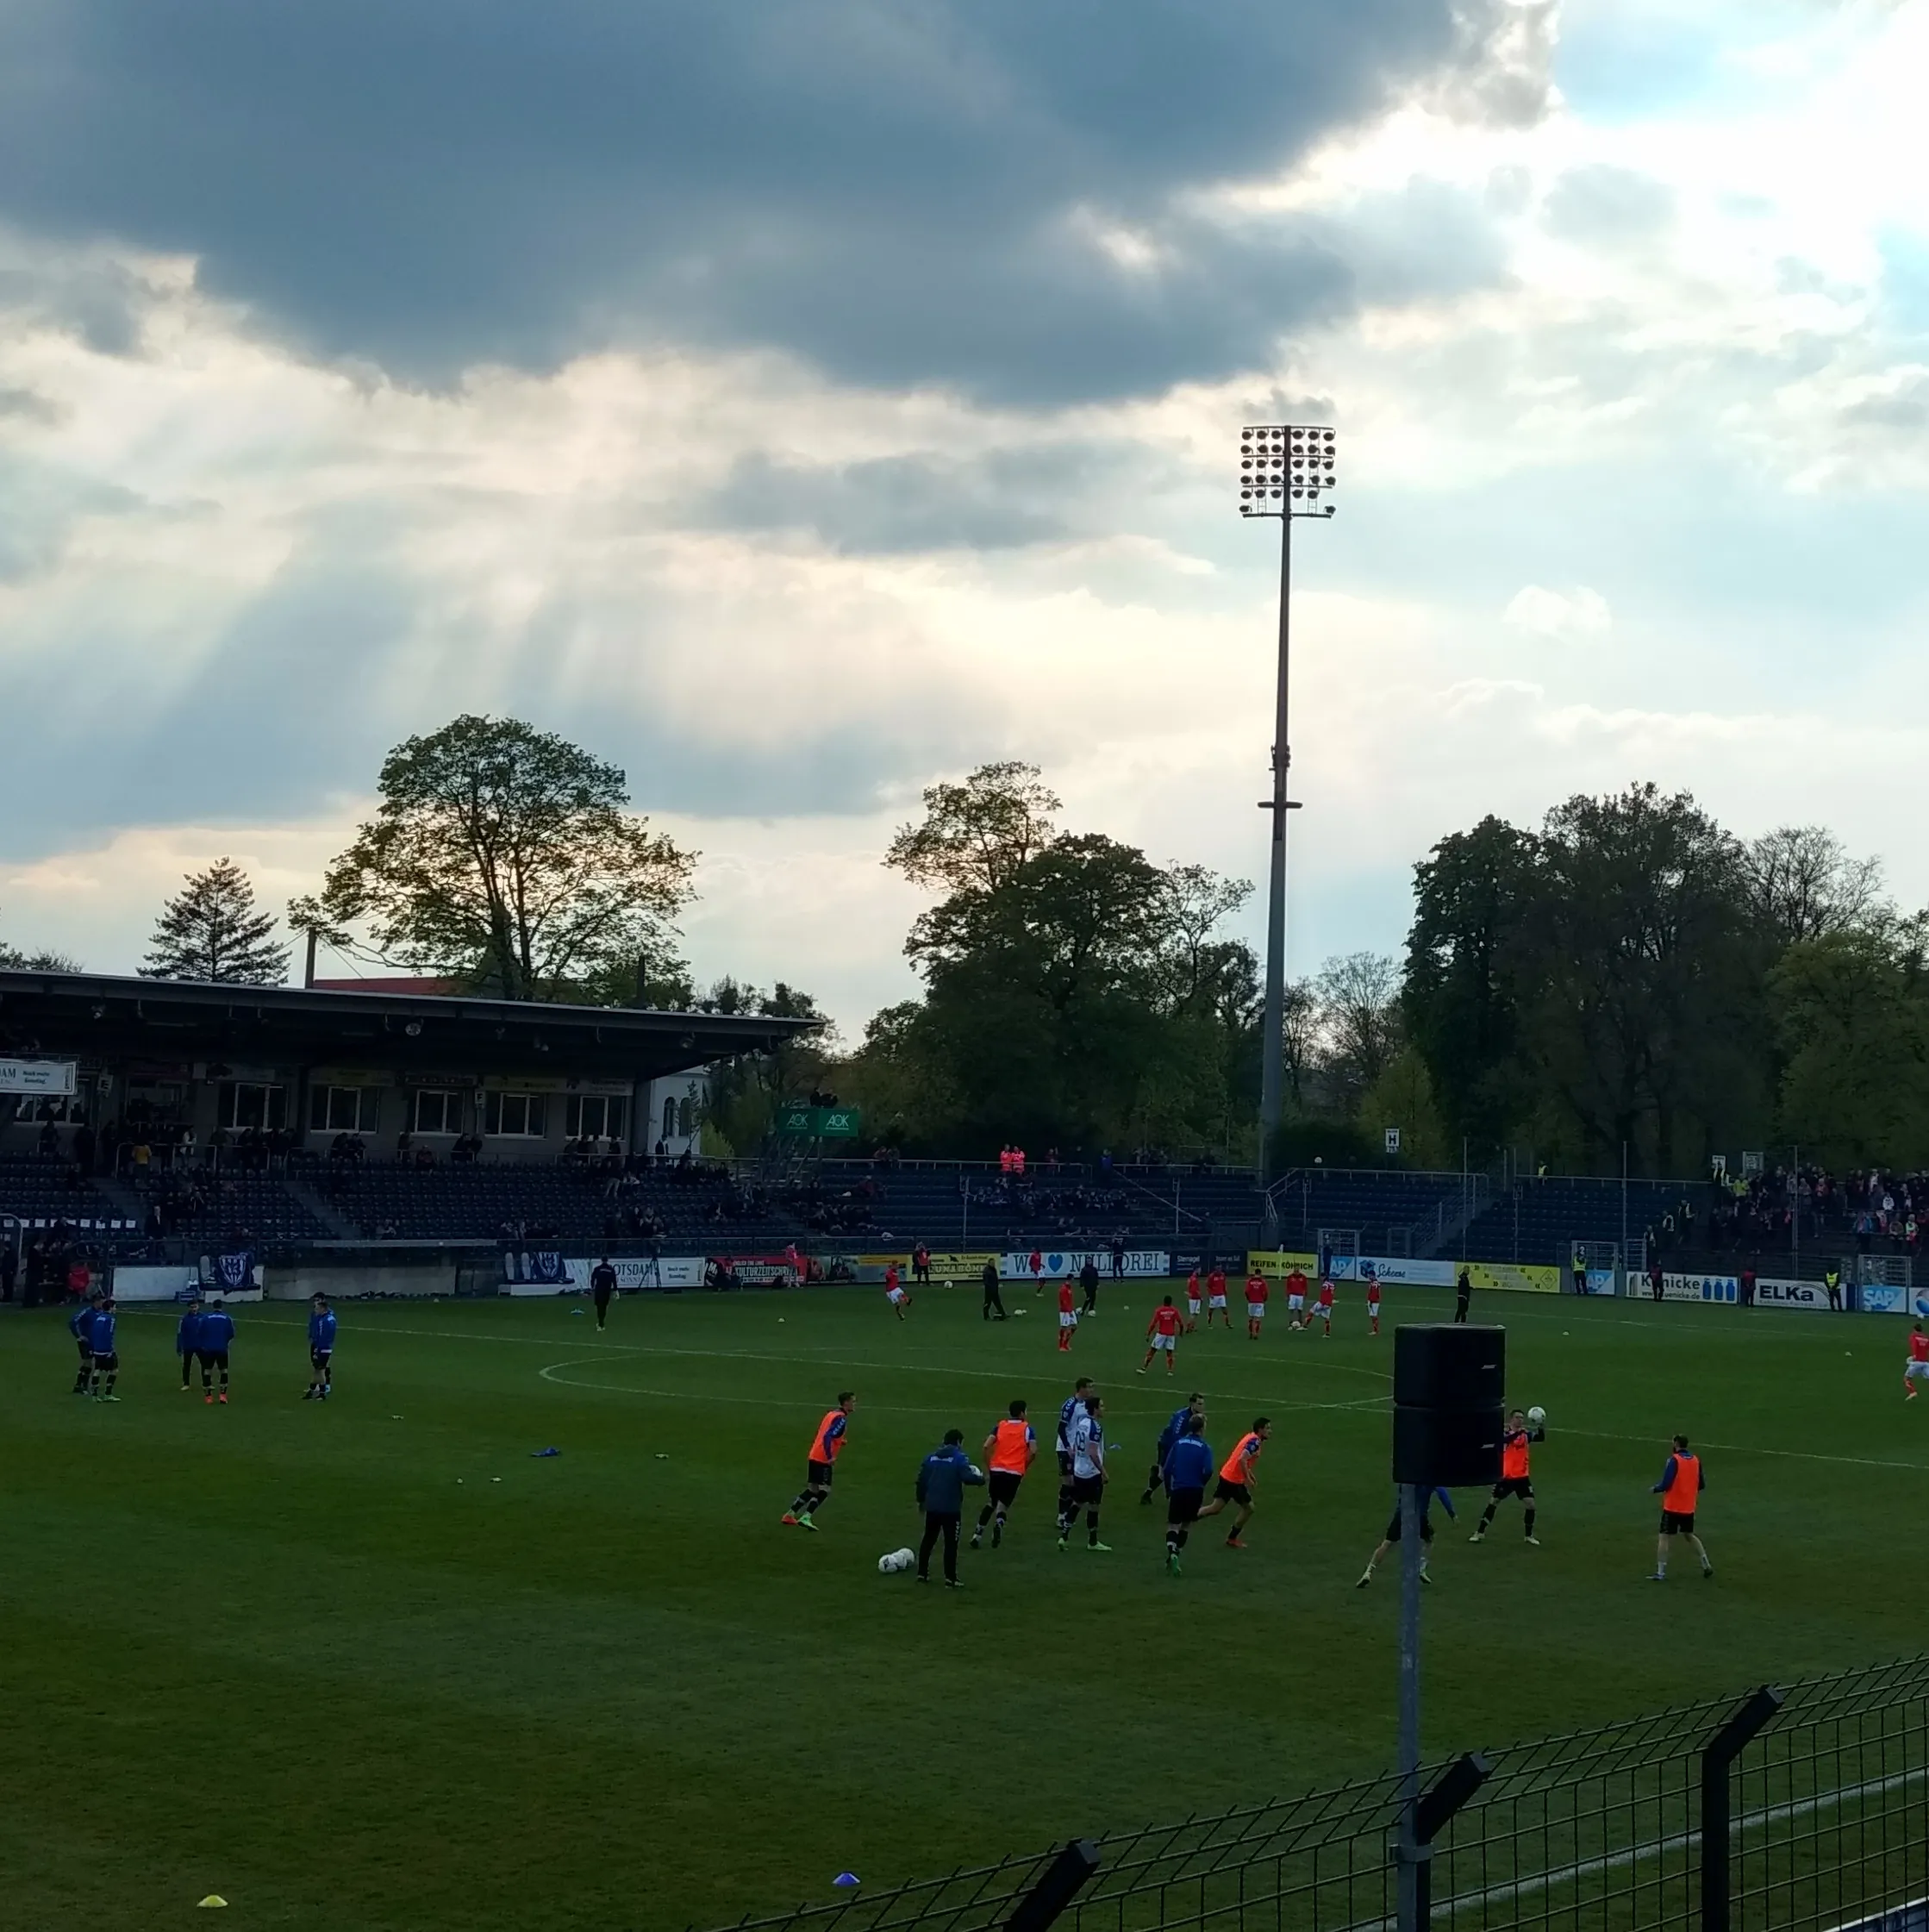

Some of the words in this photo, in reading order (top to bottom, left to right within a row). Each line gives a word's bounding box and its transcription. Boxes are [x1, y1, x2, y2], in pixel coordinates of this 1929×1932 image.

[786, 1114, 808, 1126] AOK
[825, 1115, 849, 1127] AOK
[1641, 1274, 1701, 1290] Knicke
[1863, 1290, 1895, 1306] SAP
